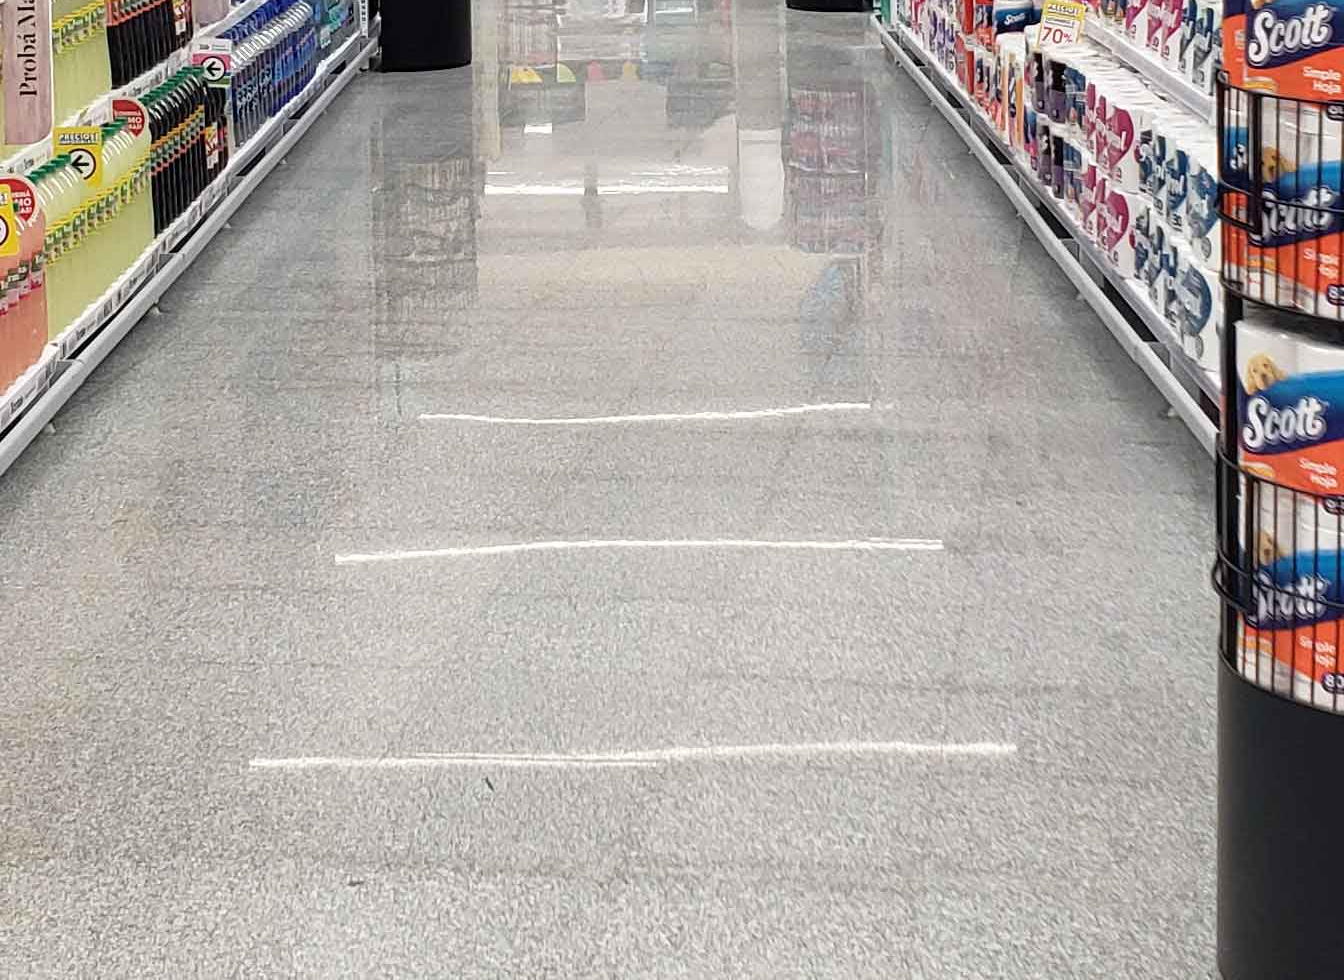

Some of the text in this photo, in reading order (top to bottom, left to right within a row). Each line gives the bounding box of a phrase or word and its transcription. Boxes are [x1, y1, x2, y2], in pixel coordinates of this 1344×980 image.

[1040, 25, 1074, 46] 70%
[1249, 6, 1335, 66] Scott
[18, 24, 38, 97] Probá
[1302, 66, 1342, 82] Simple
[1312, 79, 1342, 96] Hoja
[1244, 396, 1327, 451] Scott
